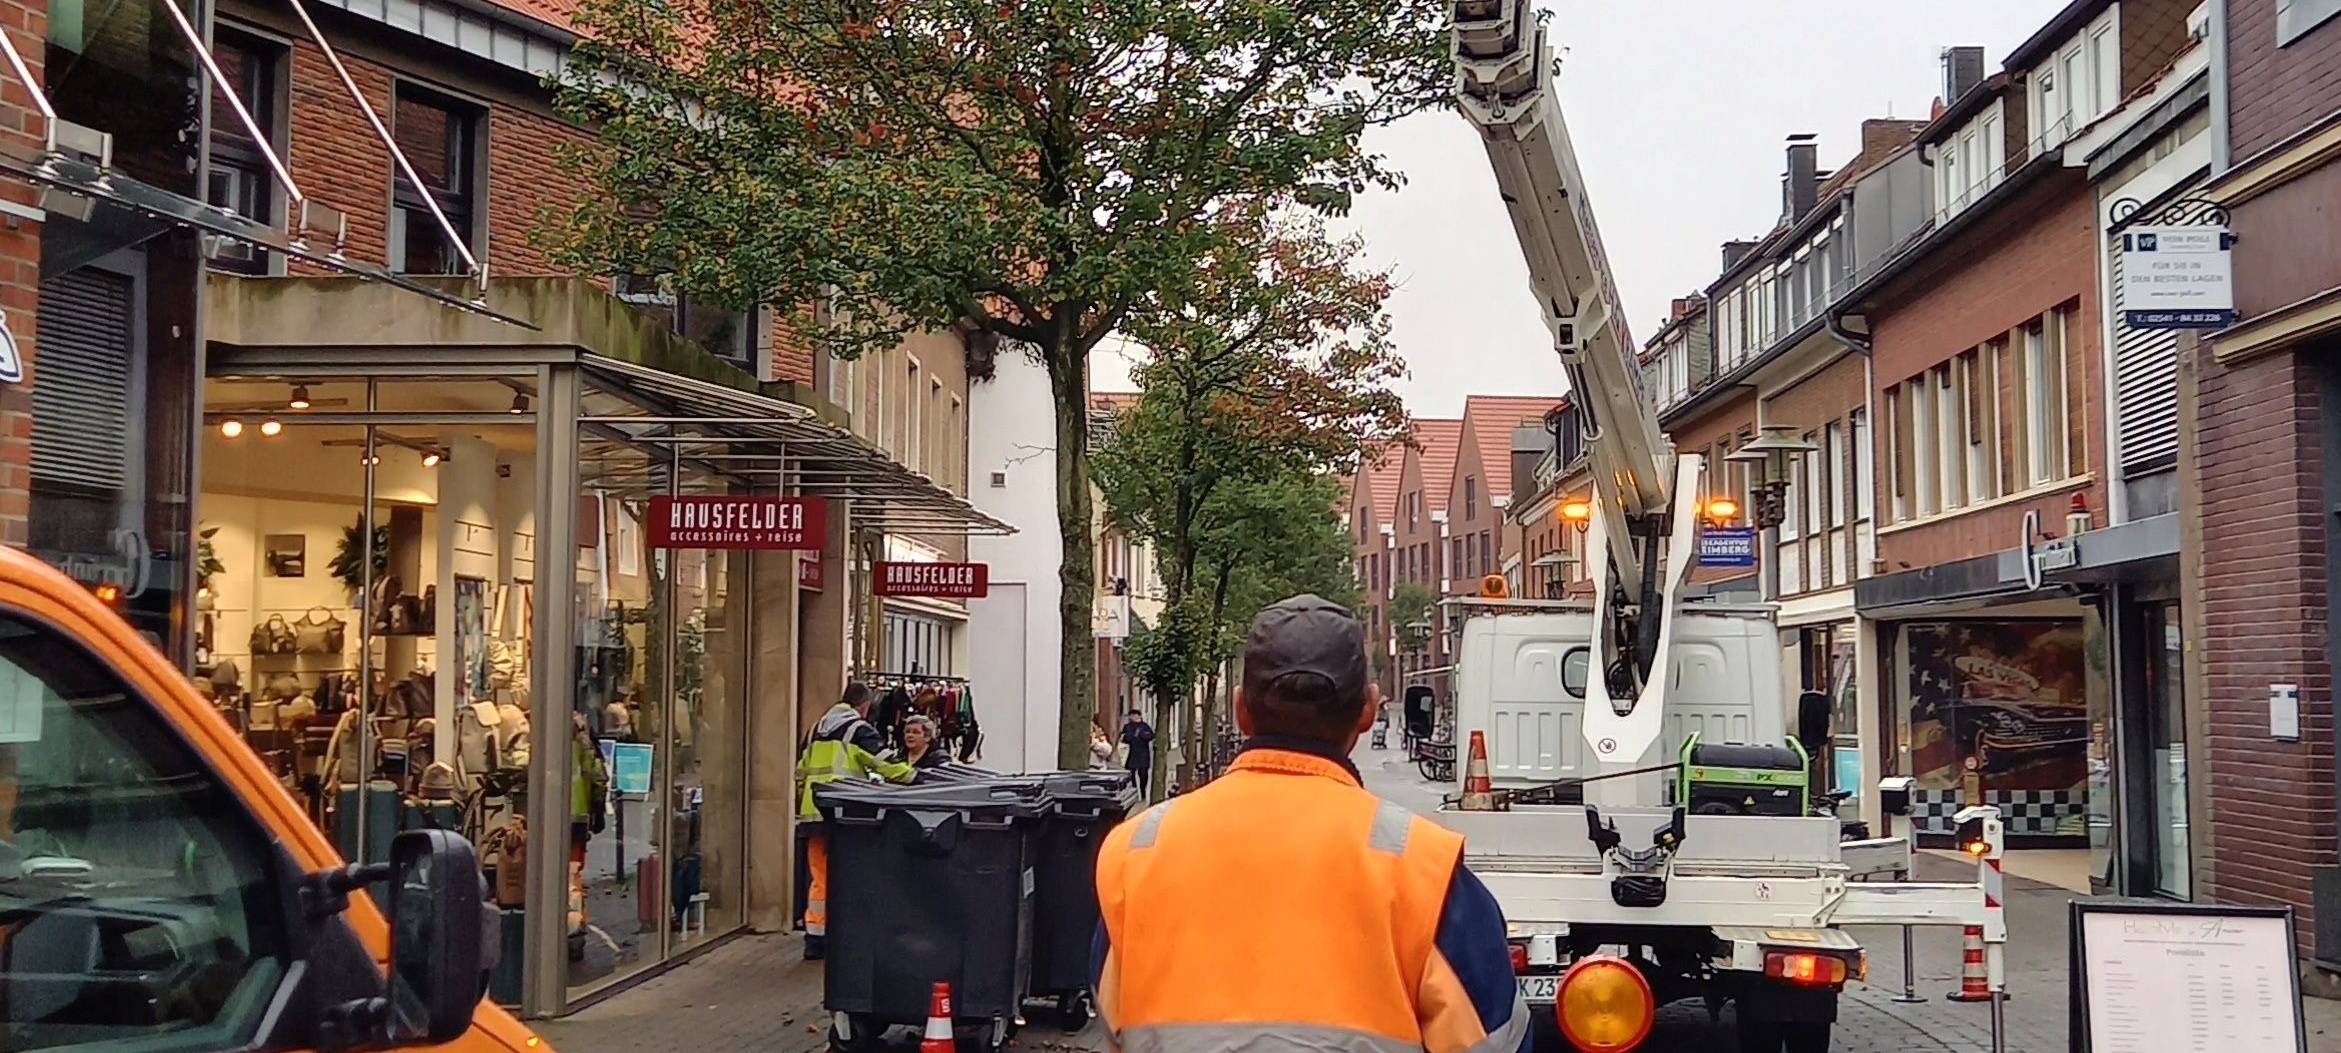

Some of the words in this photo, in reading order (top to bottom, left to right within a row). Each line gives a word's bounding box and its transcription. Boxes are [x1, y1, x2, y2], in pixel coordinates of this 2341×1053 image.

[670, 502, 803, 530] HAUSFELDER
[670, 530, 749, 542] accessoires
[754, 533, 763, 542] +
[767, 531, 802, 543] reise
[886, 566, 973, 585] HAUSFELDER
[886, 584, 939, 593] accessoires
